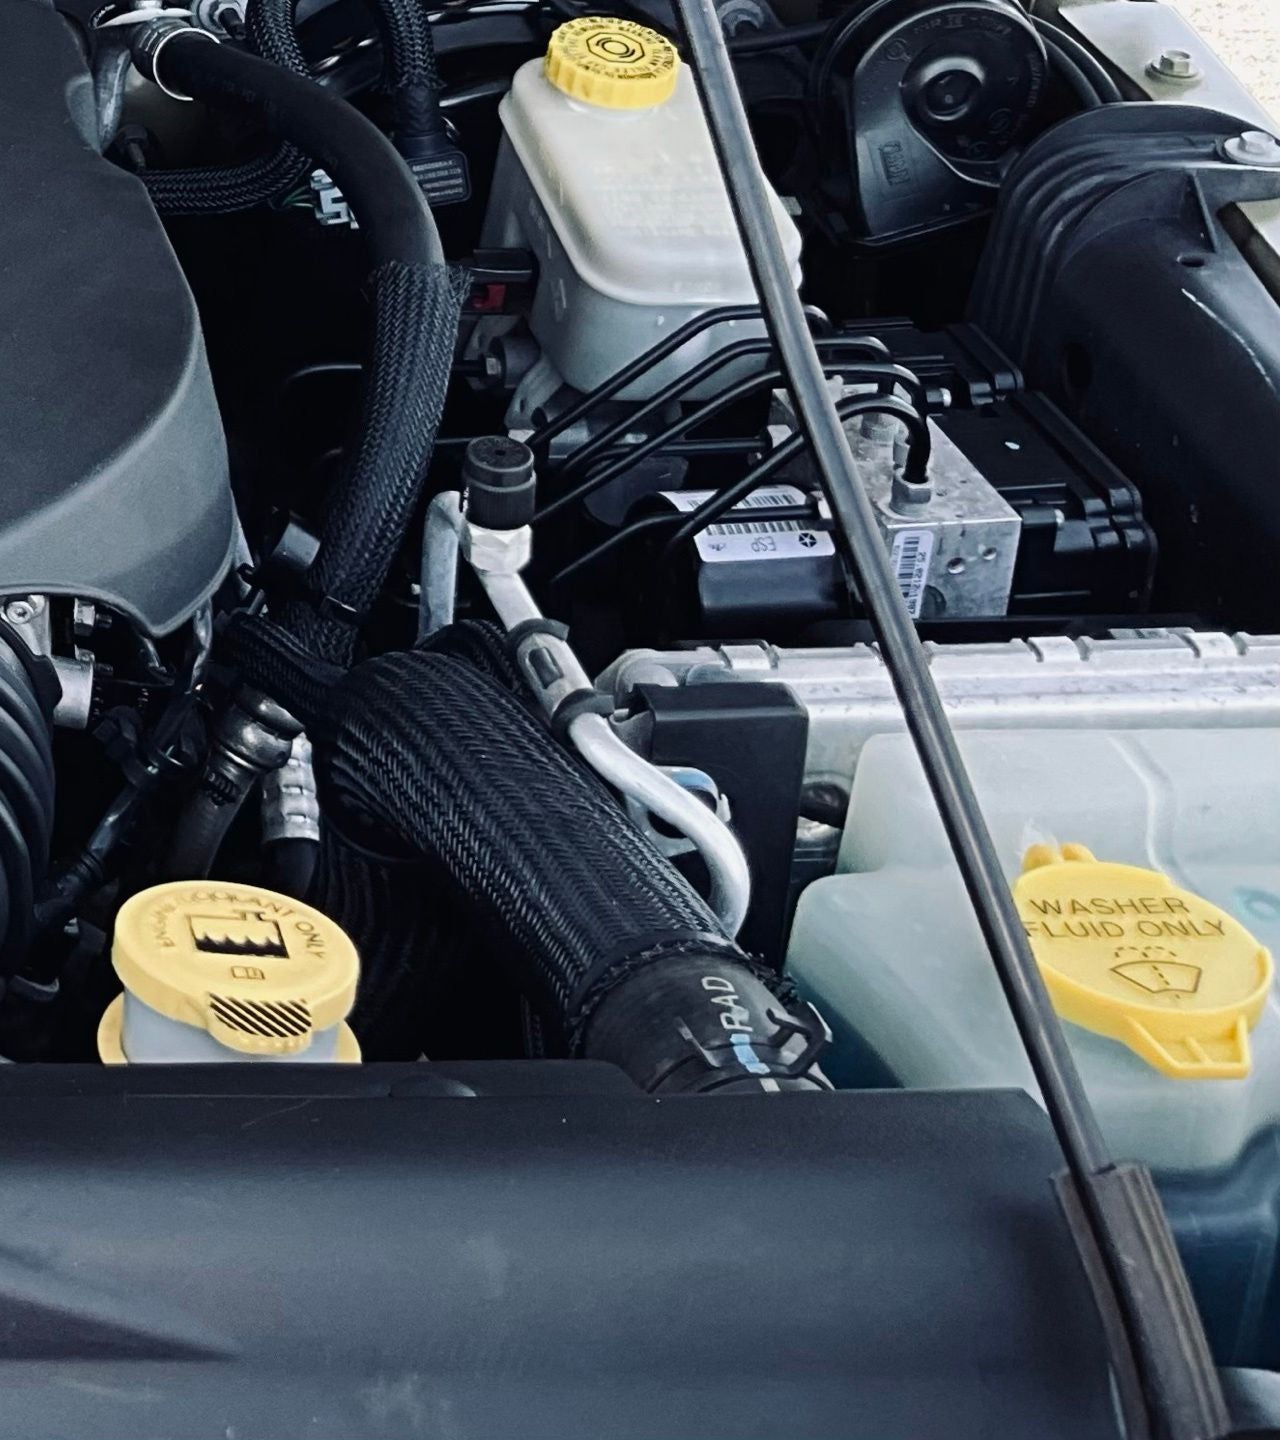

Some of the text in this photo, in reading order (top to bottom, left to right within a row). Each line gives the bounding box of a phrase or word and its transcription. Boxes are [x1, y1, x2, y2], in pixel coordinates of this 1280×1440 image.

[1029, 897, 1191, 916] WASHER
[295, 920, 327, 958] ONLY
[1023, 919, 1227, 939] FLUID ONLY
[701, 975, 754, 1033] RAD
